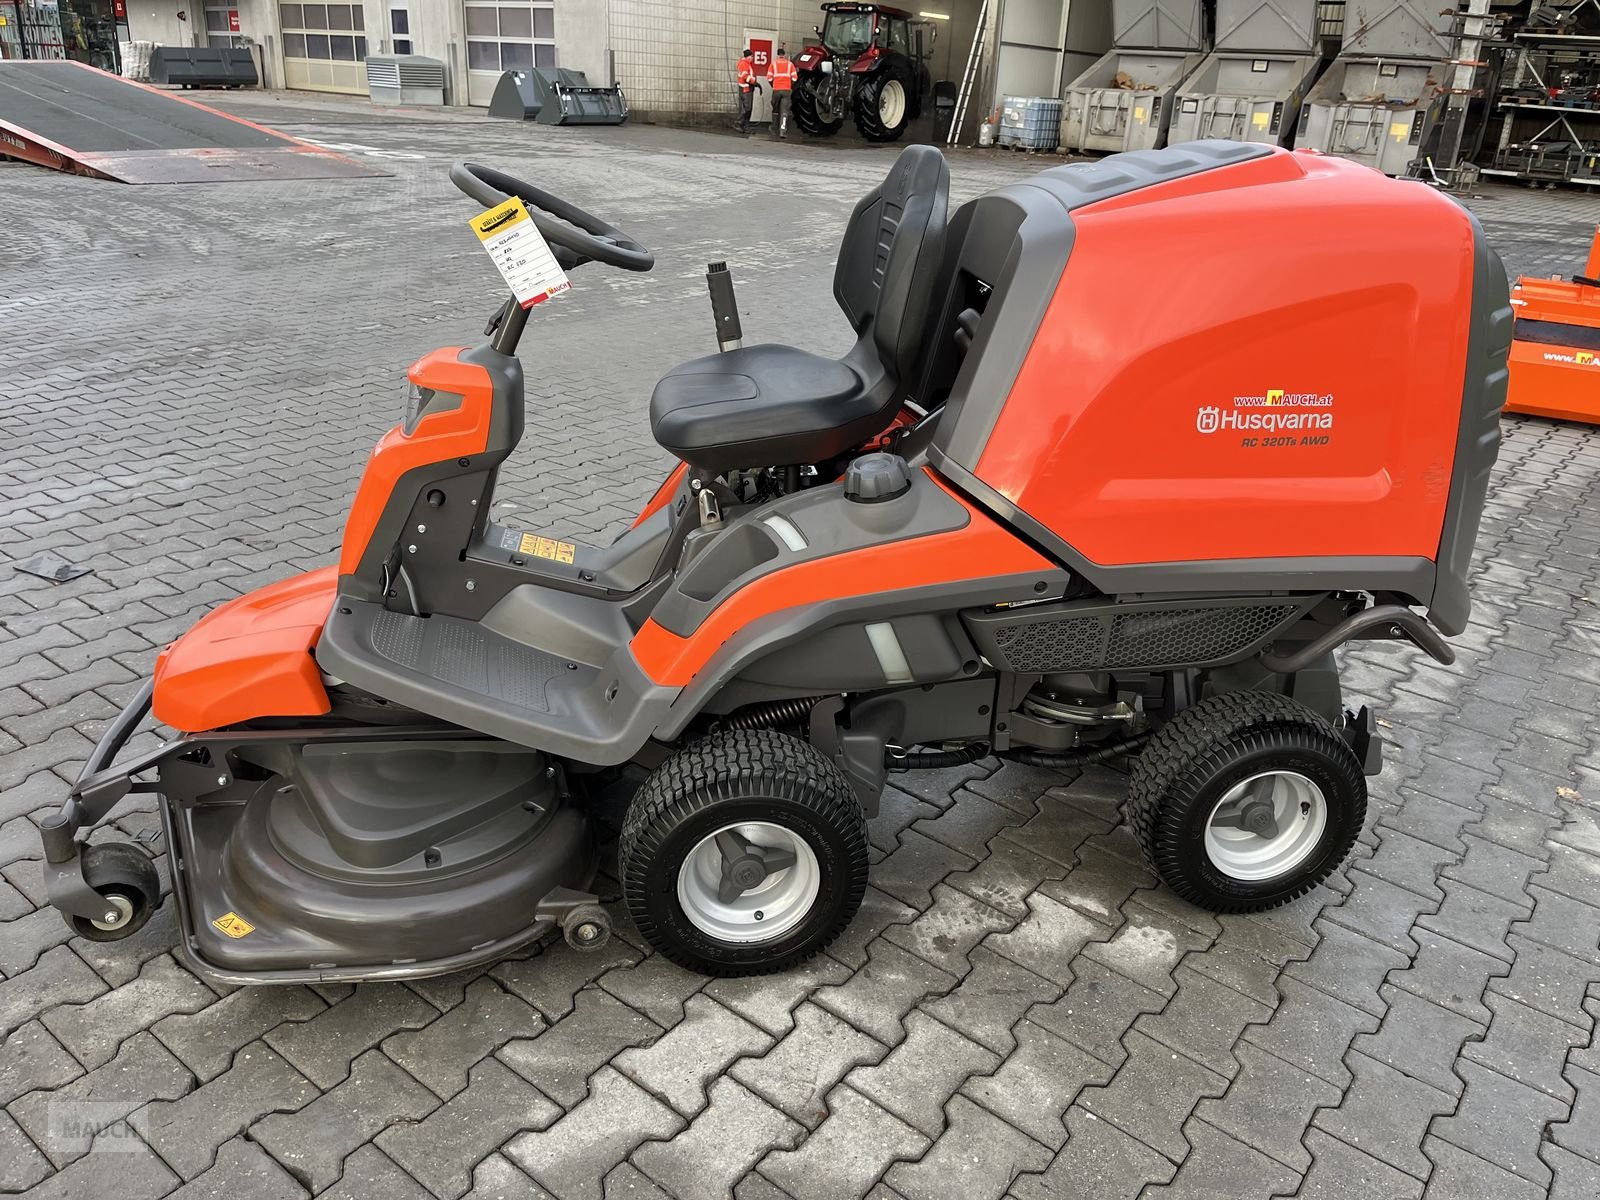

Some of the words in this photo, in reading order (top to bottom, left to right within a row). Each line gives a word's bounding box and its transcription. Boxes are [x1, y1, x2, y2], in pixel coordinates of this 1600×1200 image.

[753, 51, 767, 65] E5
[548, 282, 568, 295] MAUCH
[1234, 392, 1333, 407] www.MAUCH.at
[1221, 410, 1333, 432] Husqvarna
[1241, 438, 1258, 448] RC
[1300, 436, 1329, 446] AWD
